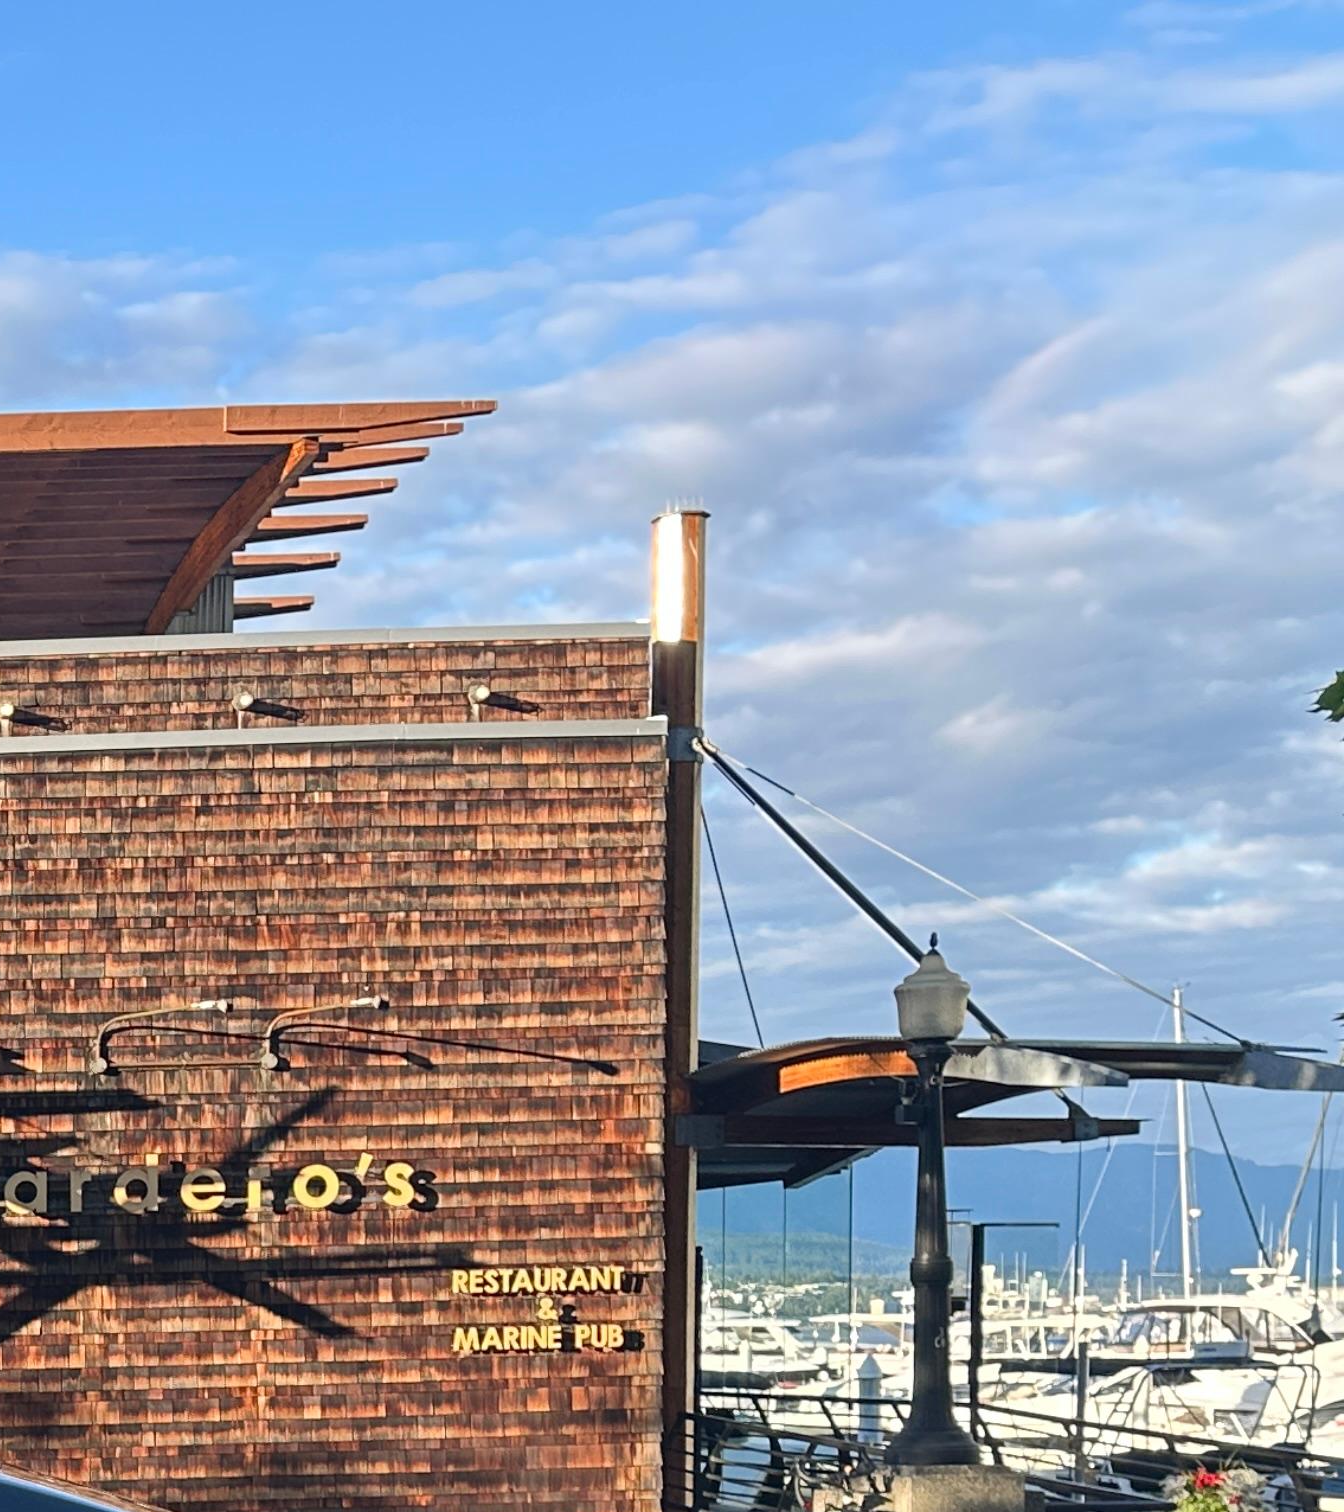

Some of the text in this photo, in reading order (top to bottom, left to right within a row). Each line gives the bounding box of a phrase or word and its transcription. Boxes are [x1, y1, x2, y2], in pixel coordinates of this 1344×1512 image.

[451, 1266, 625, 1294] RESTAURANT
[536, 1297, 558, 1321] &
[452, 1323, 625, 1352] MARINE PUB
